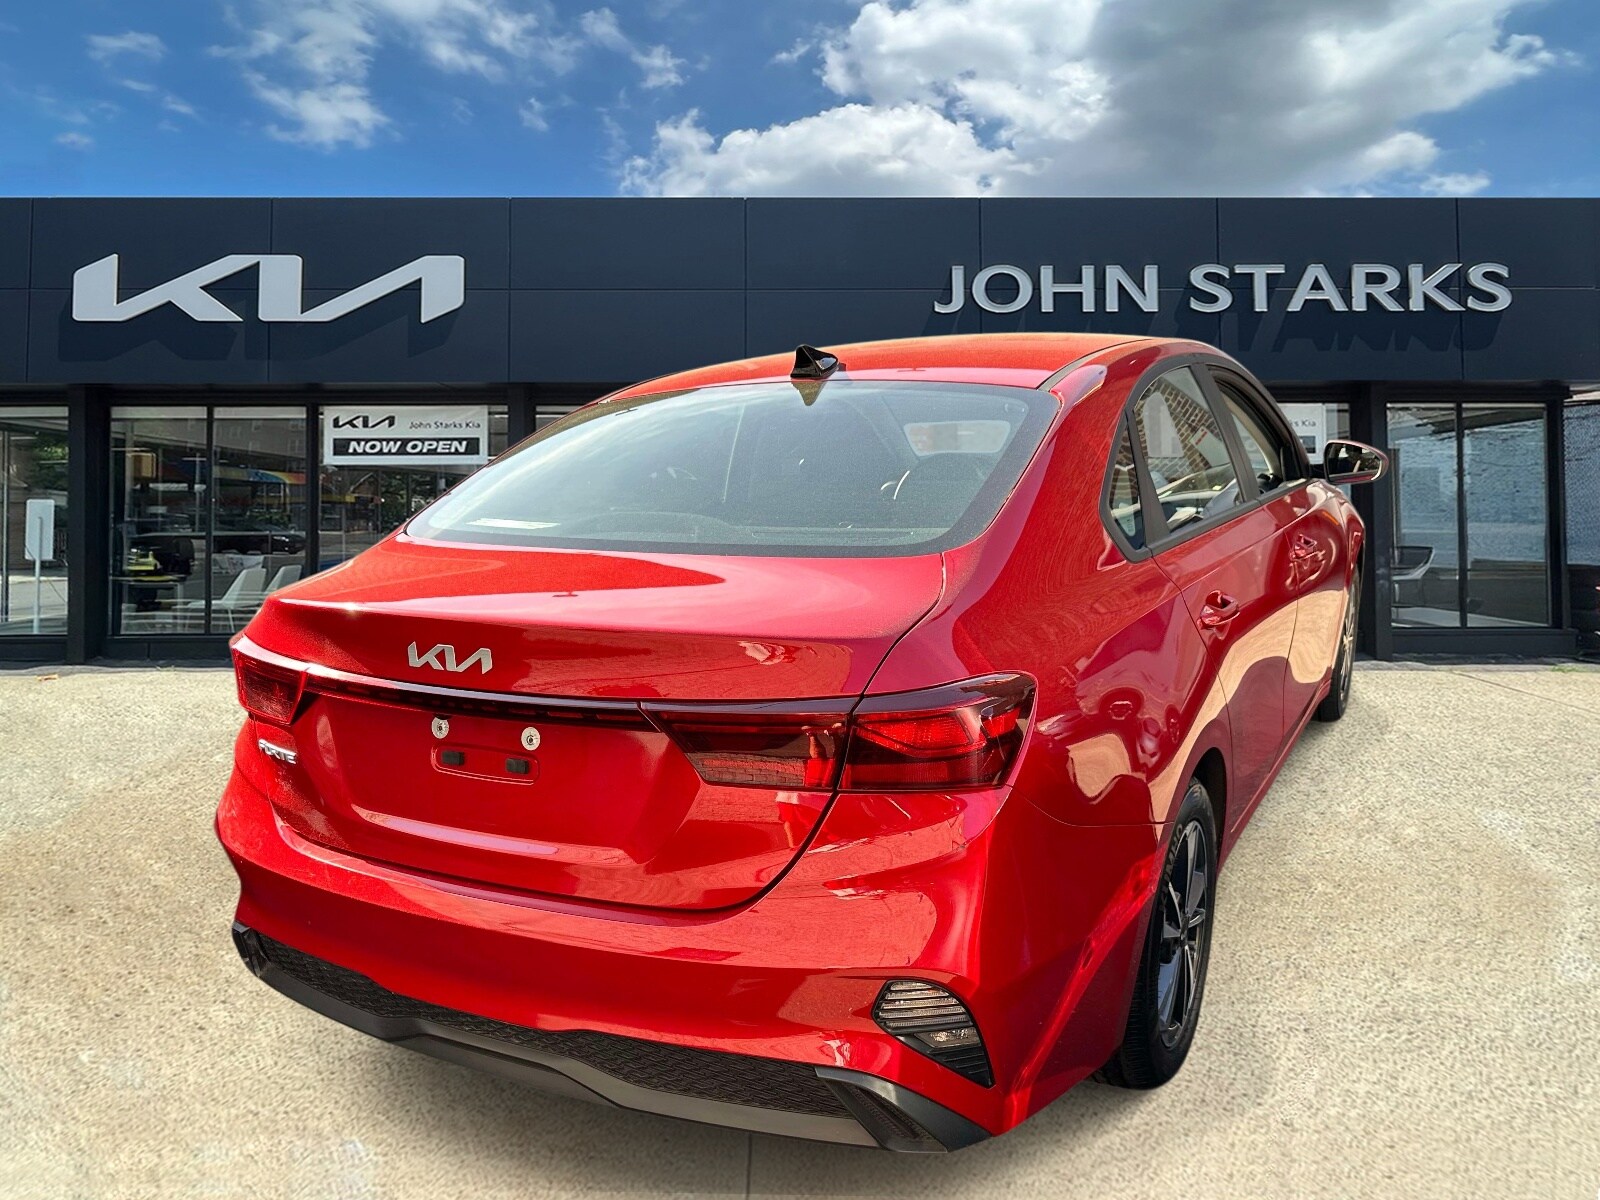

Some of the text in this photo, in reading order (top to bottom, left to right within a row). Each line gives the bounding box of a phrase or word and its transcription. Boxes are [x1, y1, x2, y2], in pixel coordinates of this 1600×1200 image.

[72, 253, 465, 323] KIA
[933, 262, 1513, 315] JOHN STARKS
[332, 414, 396, 429] KIA
[409, 420, 481, 430] John Starks Kia
[348, 440, 467, 454] NOW OPEN
[407, 640, 493, 675] KIA
